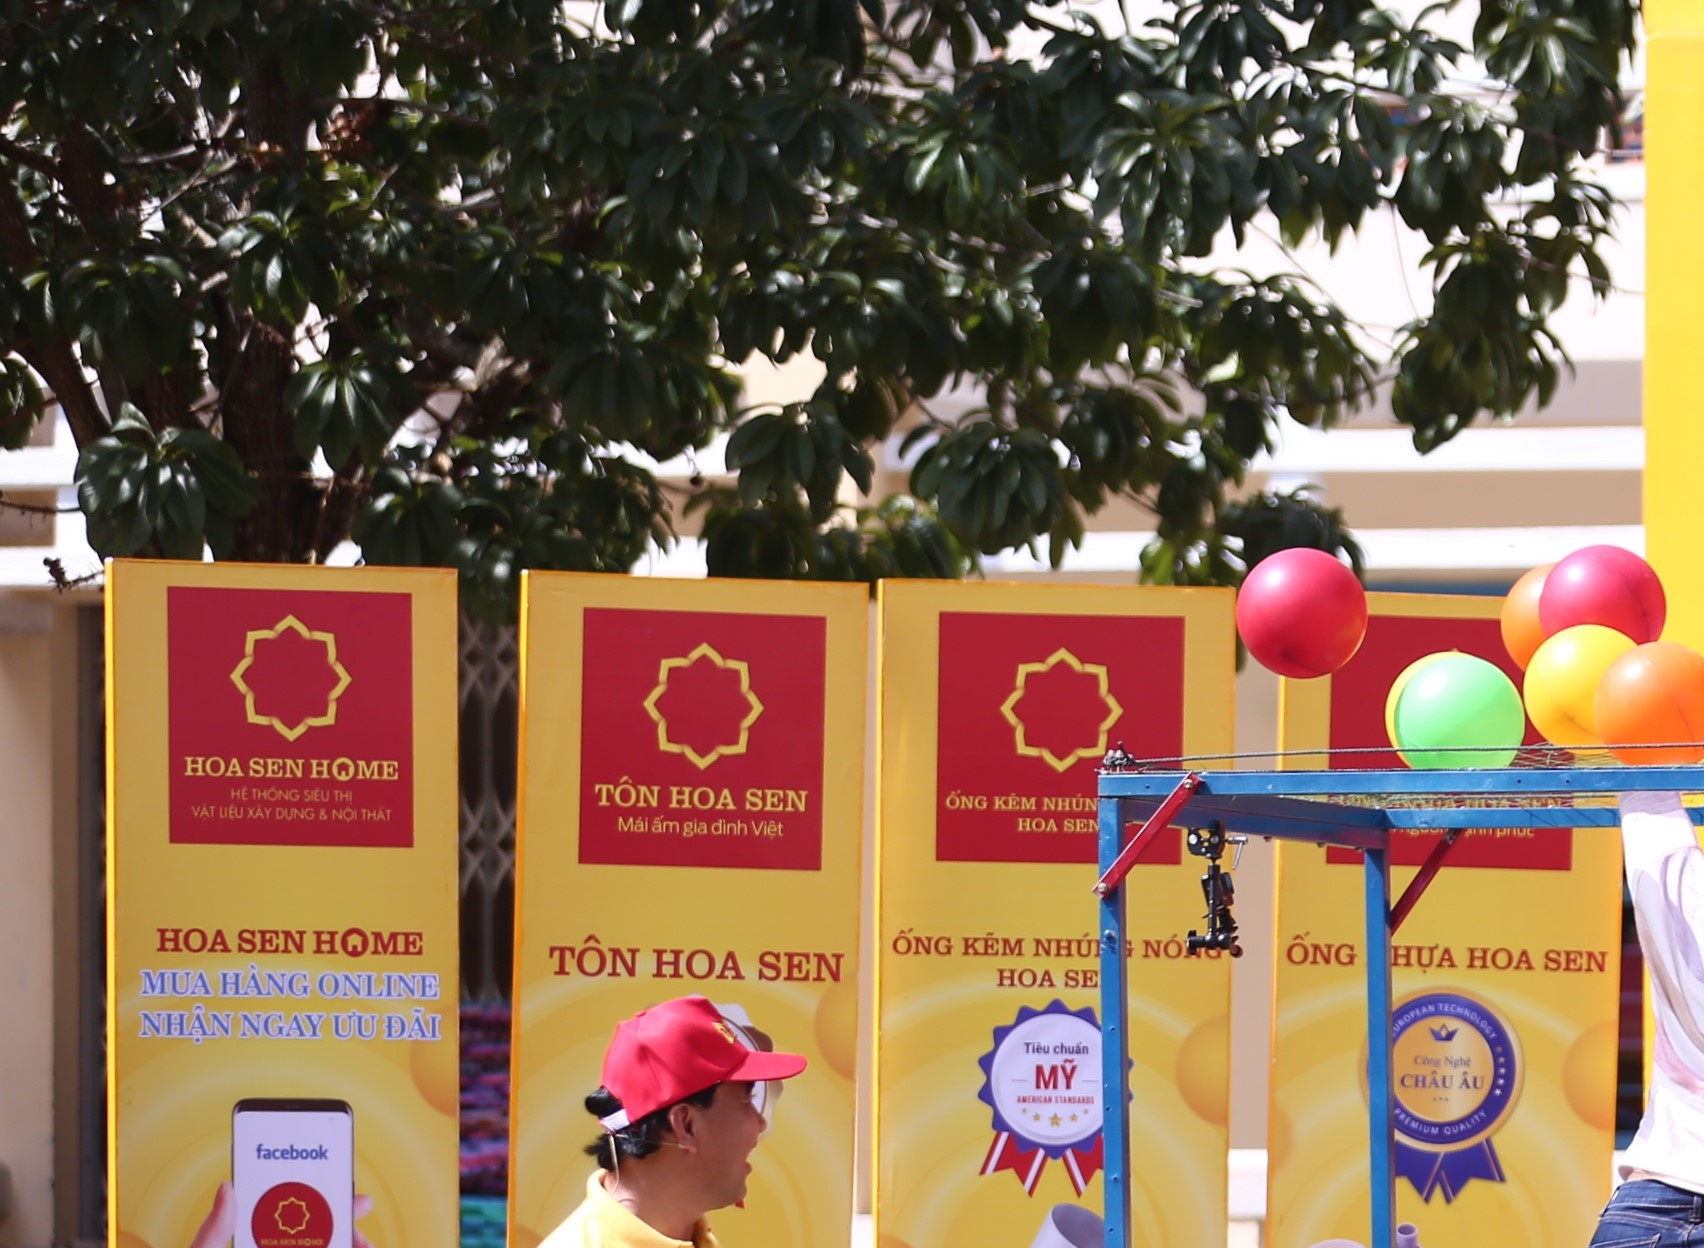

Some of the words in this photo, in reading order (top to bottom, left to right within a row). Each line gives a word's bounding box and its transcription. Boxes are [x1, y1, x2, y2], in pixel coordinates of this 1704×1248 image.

[184, 756, 244, 777] HOA
[249, 757, 304, 778] SEN
[310, 757, 399, 781] HOME
[334, 789, 353, 805] THỊ
[595, 775, 661, 808] TÔN
[669, 785, 737, 810] HOA
[745, 788, 808, 812] SEN
[945, 790, 989, 811] ỐNG
[1042, 793, 1098, 812] NHÚN
[247, 804, 272, 819] XÂY
[319, 808, 328, 820] &
[332, 806, 357, 823] NỘI
[1017, 817, 1060, 833] HOA
[1063, 818, 1099, 833] SEN
[618, 816, 648, 833] Mái
[652, 814, 680, 834] ấm
[683, 818, 708, 838] gia
[711, 818, 748, 836] đình
[751, 820, 784, 840] Việt
[156, 928, 232, 953] HOA
[237, 929, 307, 954] SEN
[313, 927, 423, 958] HOME
[892, 928, 954, 956] ỐNG
[961, 931, 1026, 957] KẼM
[1286, 931, 1358, 966] ỐNG
[1390, 943, 1458, 974] HỰA
[1466, 946, 1535, 971] HOA
[1544, 949, 1609, 973] SEN
[549, 934, 640, 978] TÔN
[652, 948, 745, 981] HOA
[758, 951, 845, 983] SEN
[140, 970, 212, 996] MUA
[219, 964, 310, 997] HÀNG
[318, 972, 440, 999] ONLINE
[997, 968, 1056, 988] HOA
[1064, 968, 1100, 988] SE
[140, 1004, 232, 1044] NHẬN
[240, 1012, 324, 1038] NGAY
[332, 1010, 377, 1039] ƯU
[384, 1009, 441, 1040] ĐÃI
[1438, 1003, 1498, 1039] TECHNOLOGY
[1024, 1042, 1050, 1054] Tiêu
[1035, 1058, 1078, 1090] MỸ
[1414, 1055, 1442, 1069] Công
[1445, 1055, 1472, 1069] Nghệ
[1400, 1070, 1454, 1089] CHÂU
[1458, 1071, 1486, 1090] ÂU
[1017, 1095, 1052, 1104] AMERICAN
[1054, 1095, 1095, 1105] STANDARDS
[1394, 1108, 1439, 1135] PREMIUM
[1444, 1110, 1487, 1135] QUALITY
[256, 1144, 329, 1160] facebook
